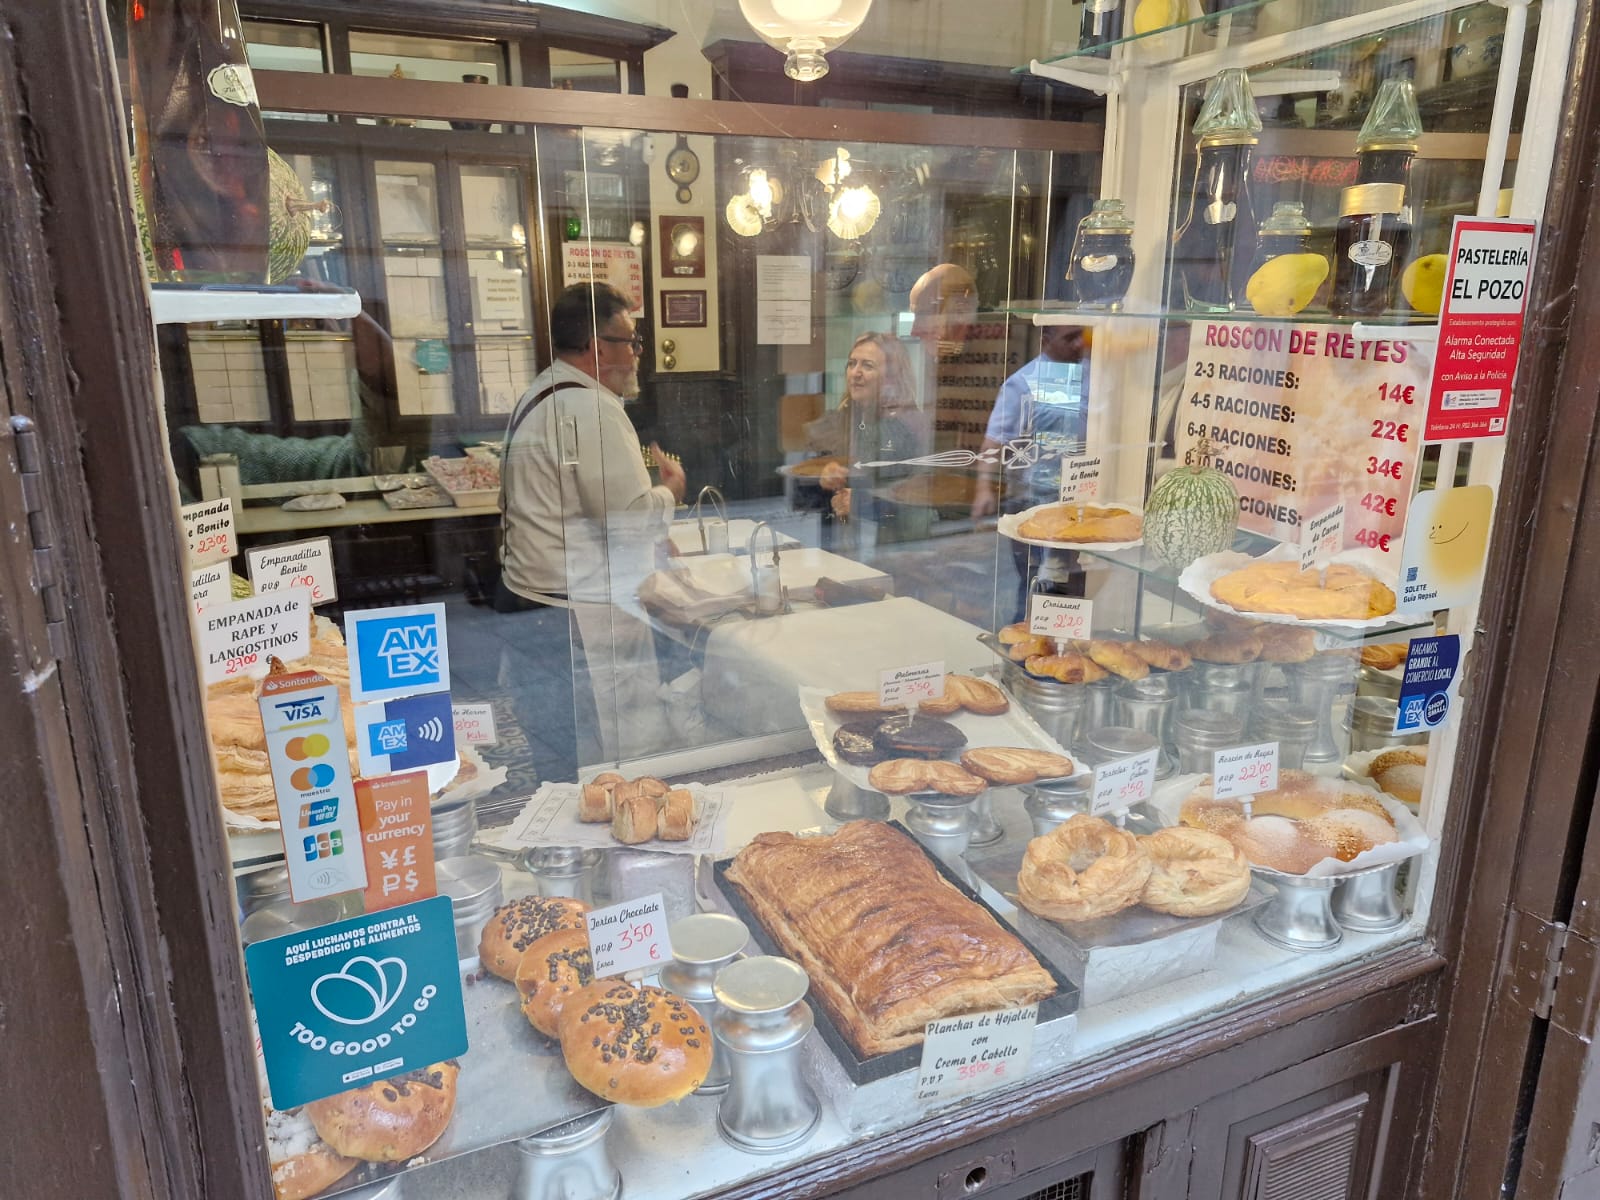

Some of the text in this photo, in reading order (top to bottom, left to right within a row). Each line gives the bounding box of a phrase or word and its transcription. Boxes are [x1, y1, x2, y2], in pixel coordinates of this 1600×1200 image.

[1457, 247, 1528, 266] PASTELERÍA
[1452, 278, 1524, 300] EL POZO
[1204, 324, 1408, 364] ROSCON DE REYES
[1444, 334, 1515, 346] Alarma Conectada
[1449, 347, 1507, 363] Alta Seguridad
[1194, 361, 1416, 405] 2-3 RACIONES: 14€
[1441, 373, 1454, 381] con
[1455, 371, 1472, 380] Aviso
[1480, 370, 1486, 380] la
[1190, 392, 1409, 443] 4-5 RACIONES: 22€
[1187, 422, 1403, 480] 6-8 RACIONES: 34€
[1214, 458, 1297, 492] RACIONES:
[1360, 492, 1397, 517] 42€
[183, 502, 230, 522] mpanada
[1310, 504, 1344, 530] Empanada
[197, 518, 230, 535] Bonito
[1240, 495, 1302, 527] CIONES:
[1355, 528, 1392, 553] 48€
[1321, 522, 1340, 538] Carne
[197, 534, 228, 554] 23'00
[221, 544, 230, 554] €
[260, 548, 322, 570] Empanadillas
[280, 562, 308, 576] Bonito
[312, 585, 324, 598] €
[1404, 584, 1428, 594] SOLETE
[1418, 590, 1438, 600] Repsol
[1042, 600, 1081, 610] Croissant
[208, 604, 281, 632] EMPANADA
[284, 601, 299, 612] de
[231, 622, 278, 642] RAPE y
[379, 626, 438, 653] AM
[208, 631, 299, 664] LANGOSTINOS
[1410, 642, 1438, 656] HAGAMOS
[389, 651, 439, 676] EX
[1408, 656, 1439, 670] GRANDE AL
[1406, 668, 1452, 684] COMERCIO LOCAL
[282, 704, 322, 722] VISA
[1427, 700, 1444, 710] SHOP
[1427, 706, 1446, 718] SMALL
[1238, 760, 1272, 780] 22'00
[1260, 775, 1270, 788] €
[300, 788, 330, 798] maestro
[300, 805, 337, 817] UnionPay
[375, 796, 412, 813] Pay in
[379, 812, 411, 830] your
[366, 824, 426, 844] currency
[303, 833, 343, 858] JCB
[620, 902, 659, 924] Chocolate
[285, 922, 421, 966] DESPERDICIO DE ALIMENTOS
[286, 914, 419, 956] AQUÍ LUCHAMOS CONTRA EL
[617, 922, 654, 951] 3'50
[649, 943, 660, 960] €
[289, 1022, 327, 1051] TOO
[329, 1032, 392, 1056] GOOD
[390, 1013, 418, 1036] TO
[413, 984, 438, 1012] GO
[928, 1008, 1037, 1036] Planchas de Hojaldre
[971, 1035, 988, 1046] con
[935, 1056, 966, 1070] Crema
[980, 1046, 1018, 1061] Cabello
